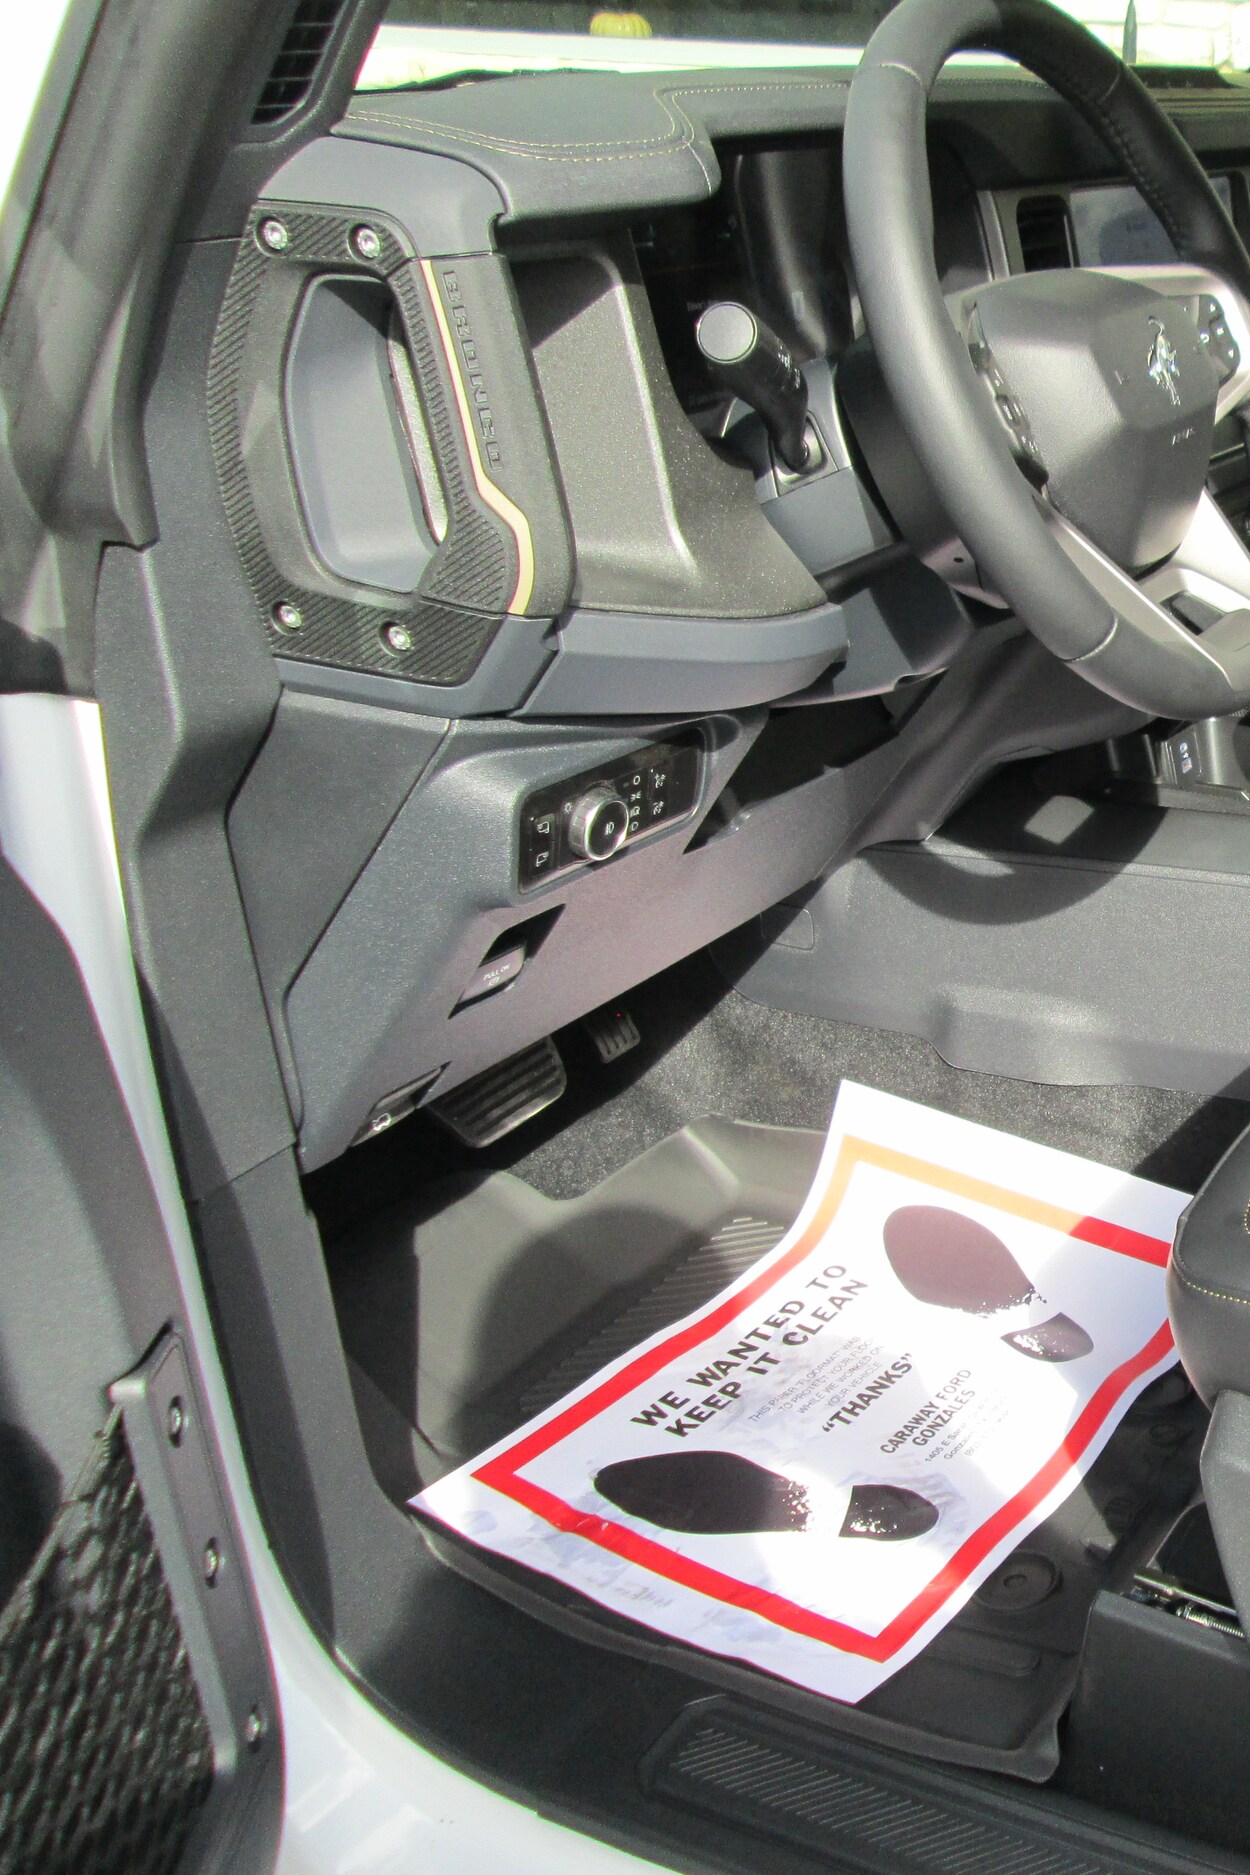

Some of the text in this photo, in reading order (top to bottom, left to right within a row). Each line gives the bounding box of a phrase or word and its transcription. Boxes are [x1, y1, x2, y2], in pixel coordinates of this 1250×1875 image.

[443, 271, 503, 471] BRONCO
[630, 1265, 847, 1428] WE WANTED TO
[664, 1279, 869, 1438] KEEP IT CLEAN
[748, 1406, 770, 1422] THIS
[841, 1336, 862, 1352] WAS
[778, 1402, 793, 1413] TO
[792, 1375, 829, 1404] PROTECT
[828, 1358, 851, 1375] YOUR
[797, 1392, 826, 1414] WHILE
[823, 1382, 839, 1394] WE
[837, 1356, 872, 1383] WORKED
[825, 1361, 883, 1408] YOUR VEHICLE
[880, 1401, 940, 1454] CARAWAY
[935, 1369, 971, 1401] FORD
[912, 1389, 975, 1446] GONZALES
[925, 1446, 944, 1463] 1405
